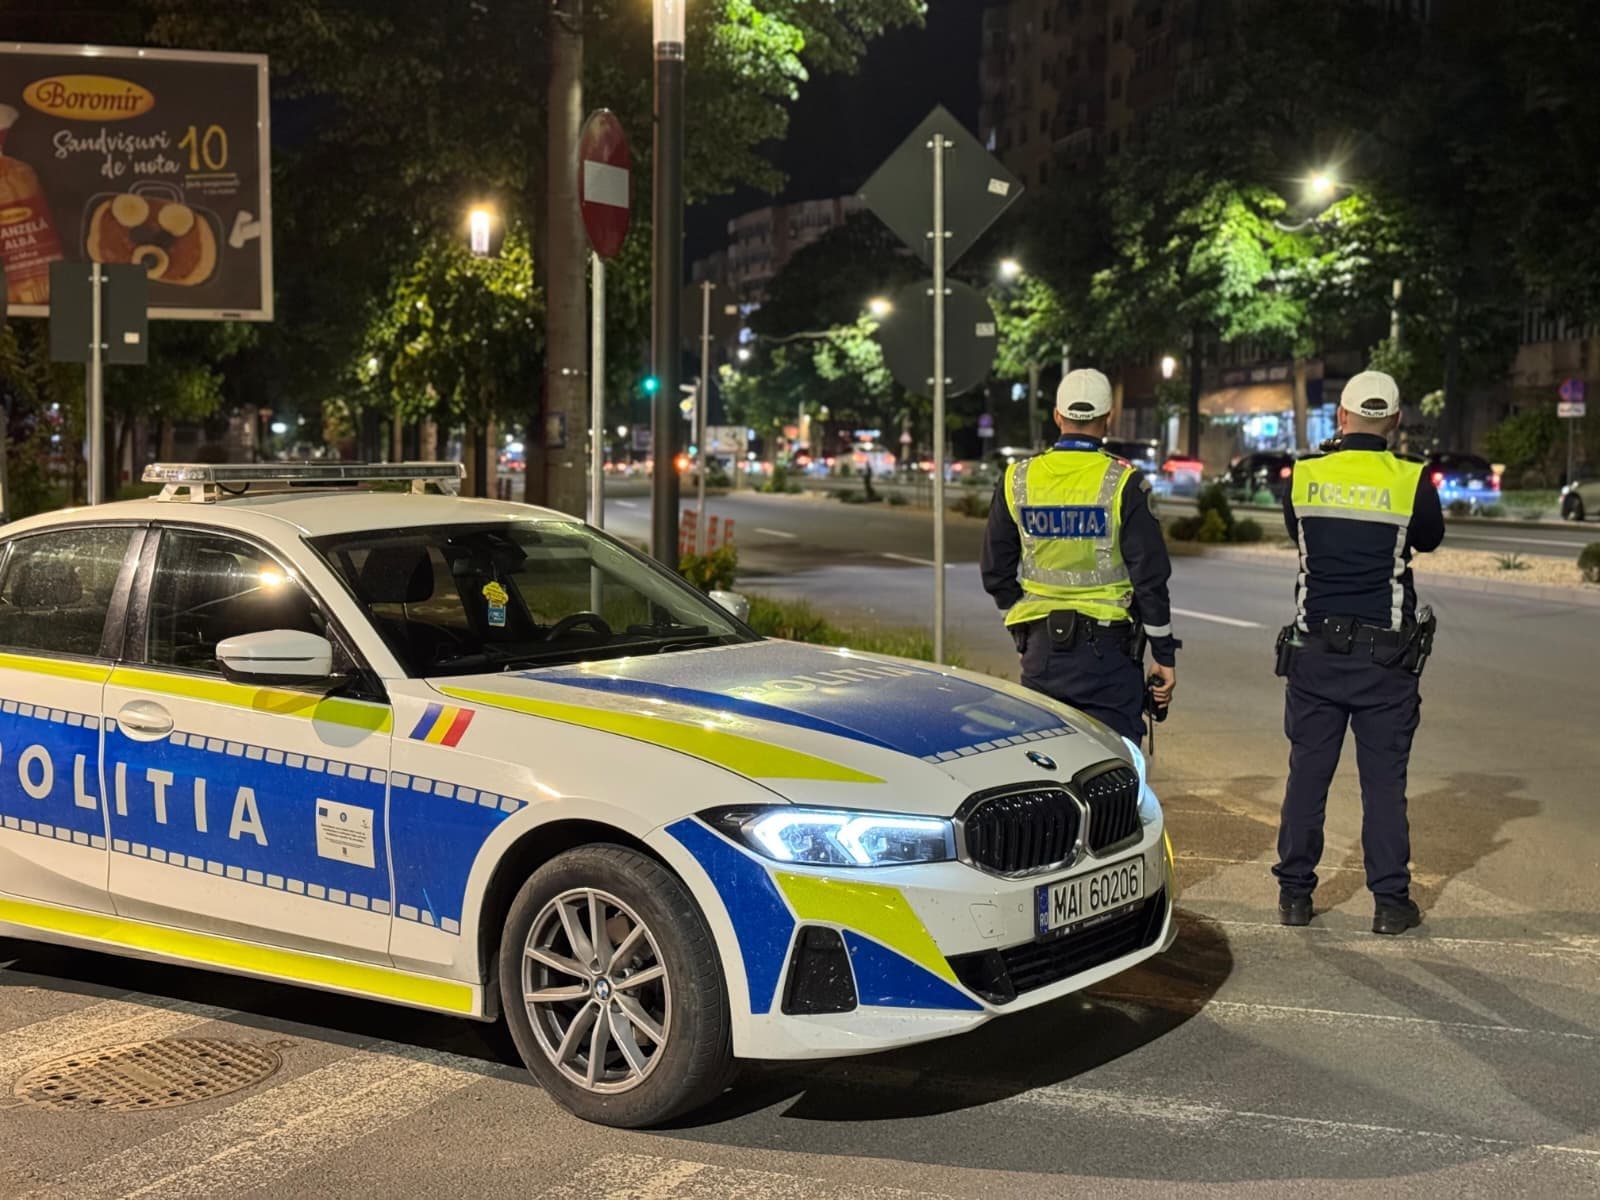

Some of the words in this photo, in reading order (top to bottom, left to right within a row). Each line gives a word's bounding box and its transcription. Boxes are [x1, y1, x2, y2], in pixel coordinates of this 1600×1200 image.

[36, 81, 144, 111] Boromir
[178, 125, 228, 170] 10
[102, 154, 127, 179] de
[1308, 482, 1391, 510] POLITIA
[1025, 511, 1101, 533] POLITIA
[0, 741, 268, 846] OLITIA
[1055, 882, 1082, 924] MAI
[1090, 864, 1138, 910] 60206
